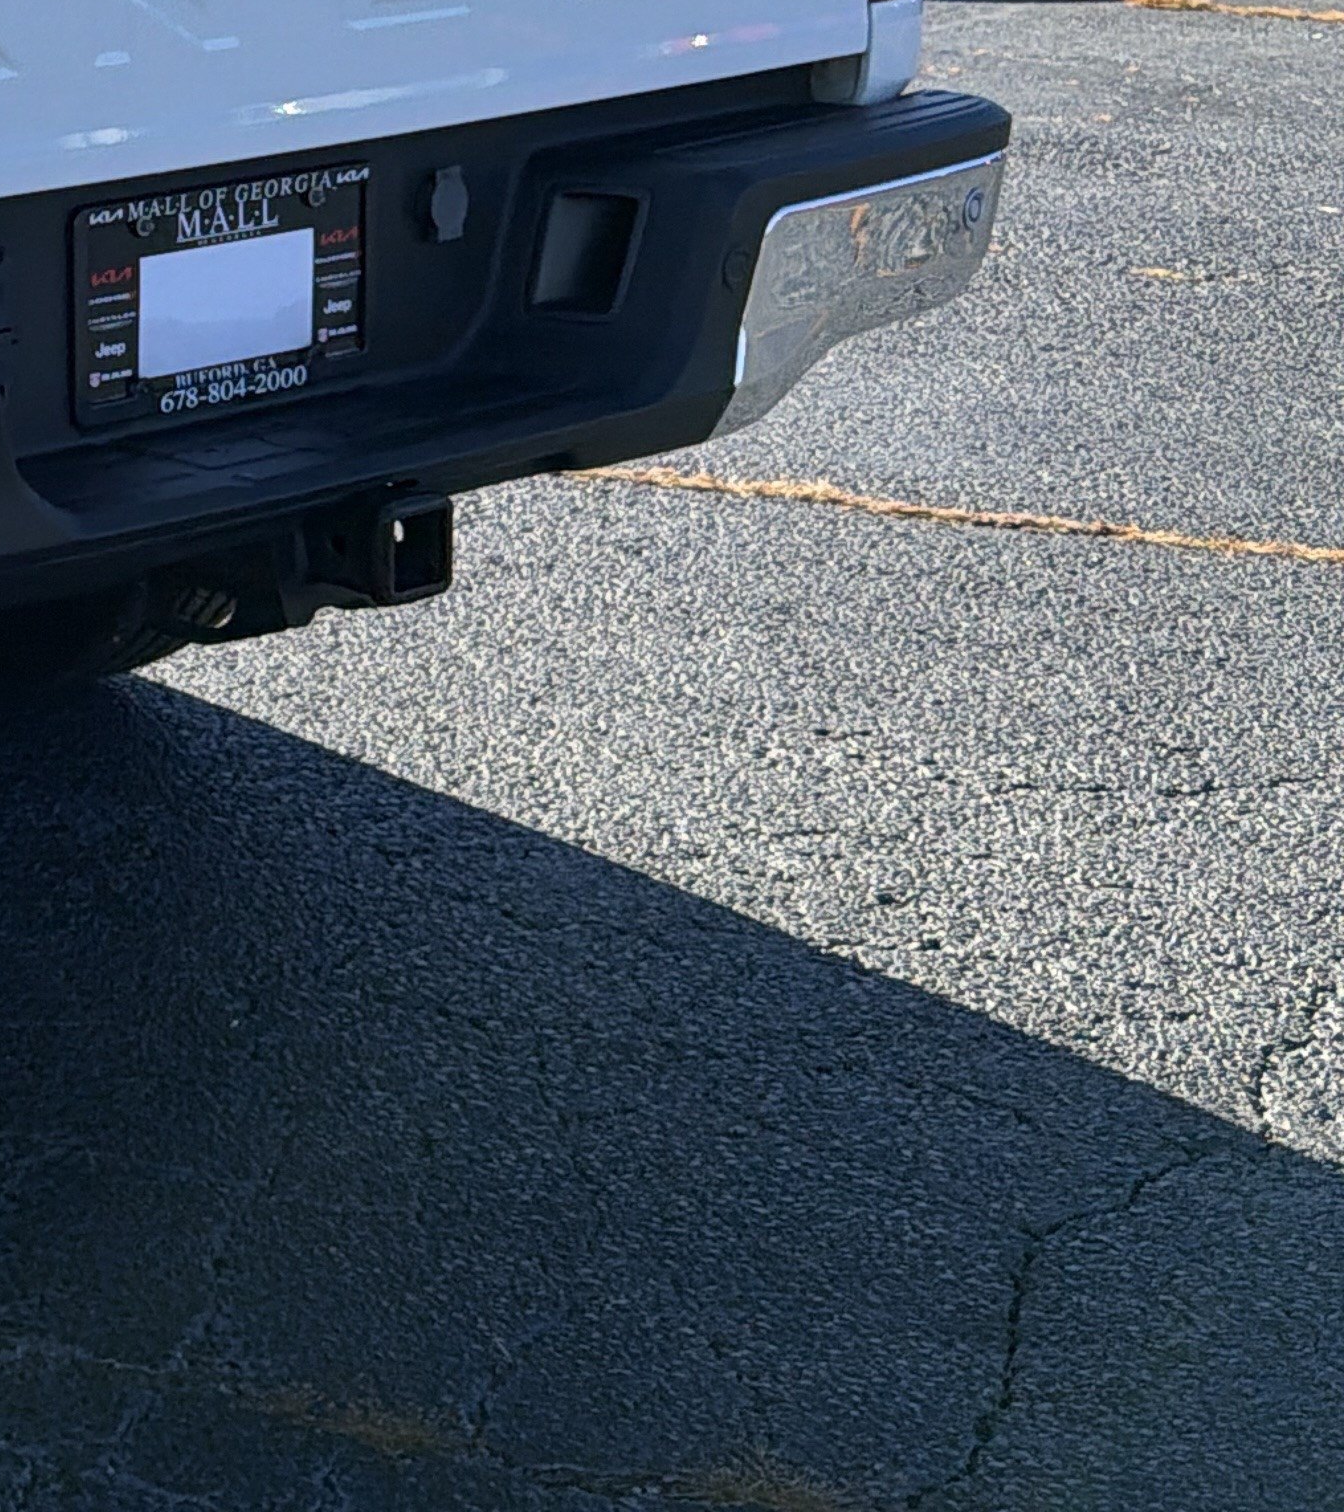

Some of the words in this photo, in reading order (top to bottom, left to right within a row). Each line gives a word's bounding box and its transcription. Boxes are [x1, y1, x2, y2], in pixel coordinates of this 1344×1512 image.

[199, 187, 228, 210] OF
[234, 172, 332, 203] GEORGIA
[323, 299, 353, 314] Jeep
[94, 342, 126, 358] Jeep
[160, 364, 308, 414] 678-804-2000
